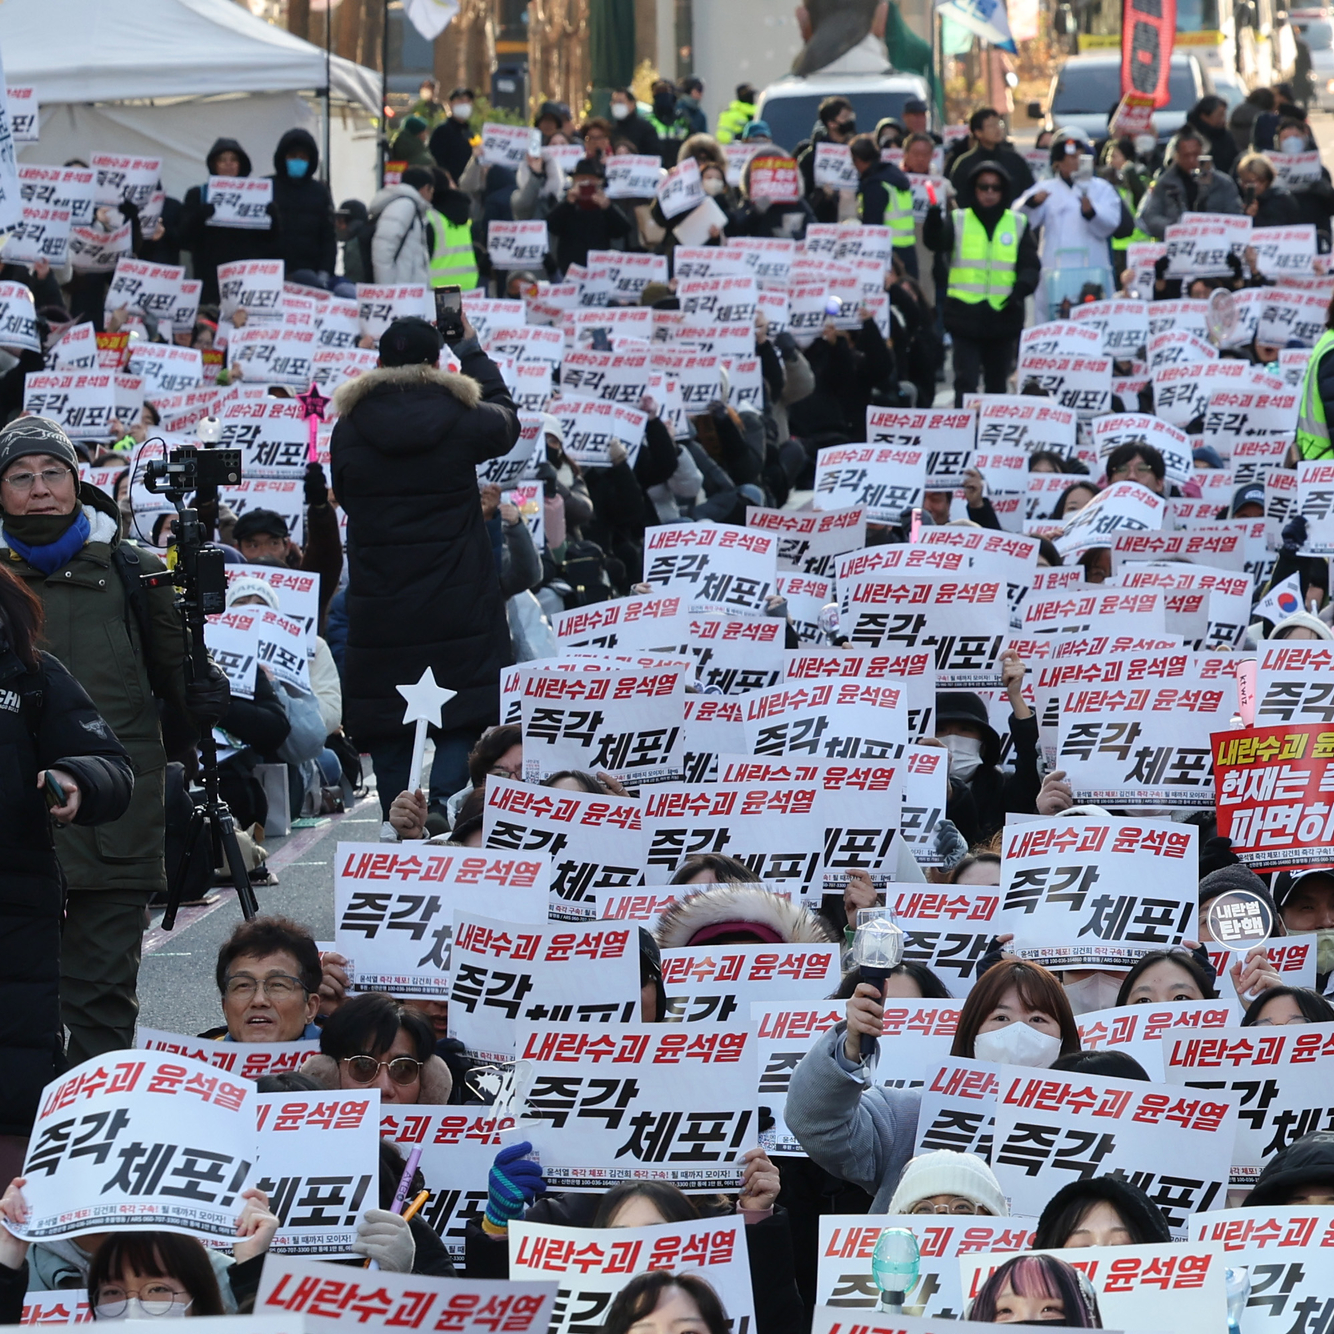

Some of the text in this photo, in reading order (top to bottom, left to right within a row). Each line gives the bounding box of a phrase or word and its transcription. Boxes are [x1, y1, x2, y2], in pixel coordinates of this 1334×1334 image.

[649, 530, 771, 554] 내란수괴 윤석열
[647, 555, 770, 609] 즉각 체포!
[1217, 733, 1309, 765] 내란수괴
[1220, 765, 1311, 805] 헌재는
[1215, 900, 1260, 919] 내란범
[1219, 916, 1265, 940] 탄핵
[523, 1032, 747, 1064] 내란수괴 윤석열
[41, 1062, 246, 1118] 내란수괴 윤석열
[520, 1077, 752, 1162] 즉각 체포!
[24, 1109, 251, 1202] 즉각 체포!
[547, 1168, 731, 1179] 윤석열 즉각 체포! 김건희 즉각 구속! 될 때까지 모이자!
